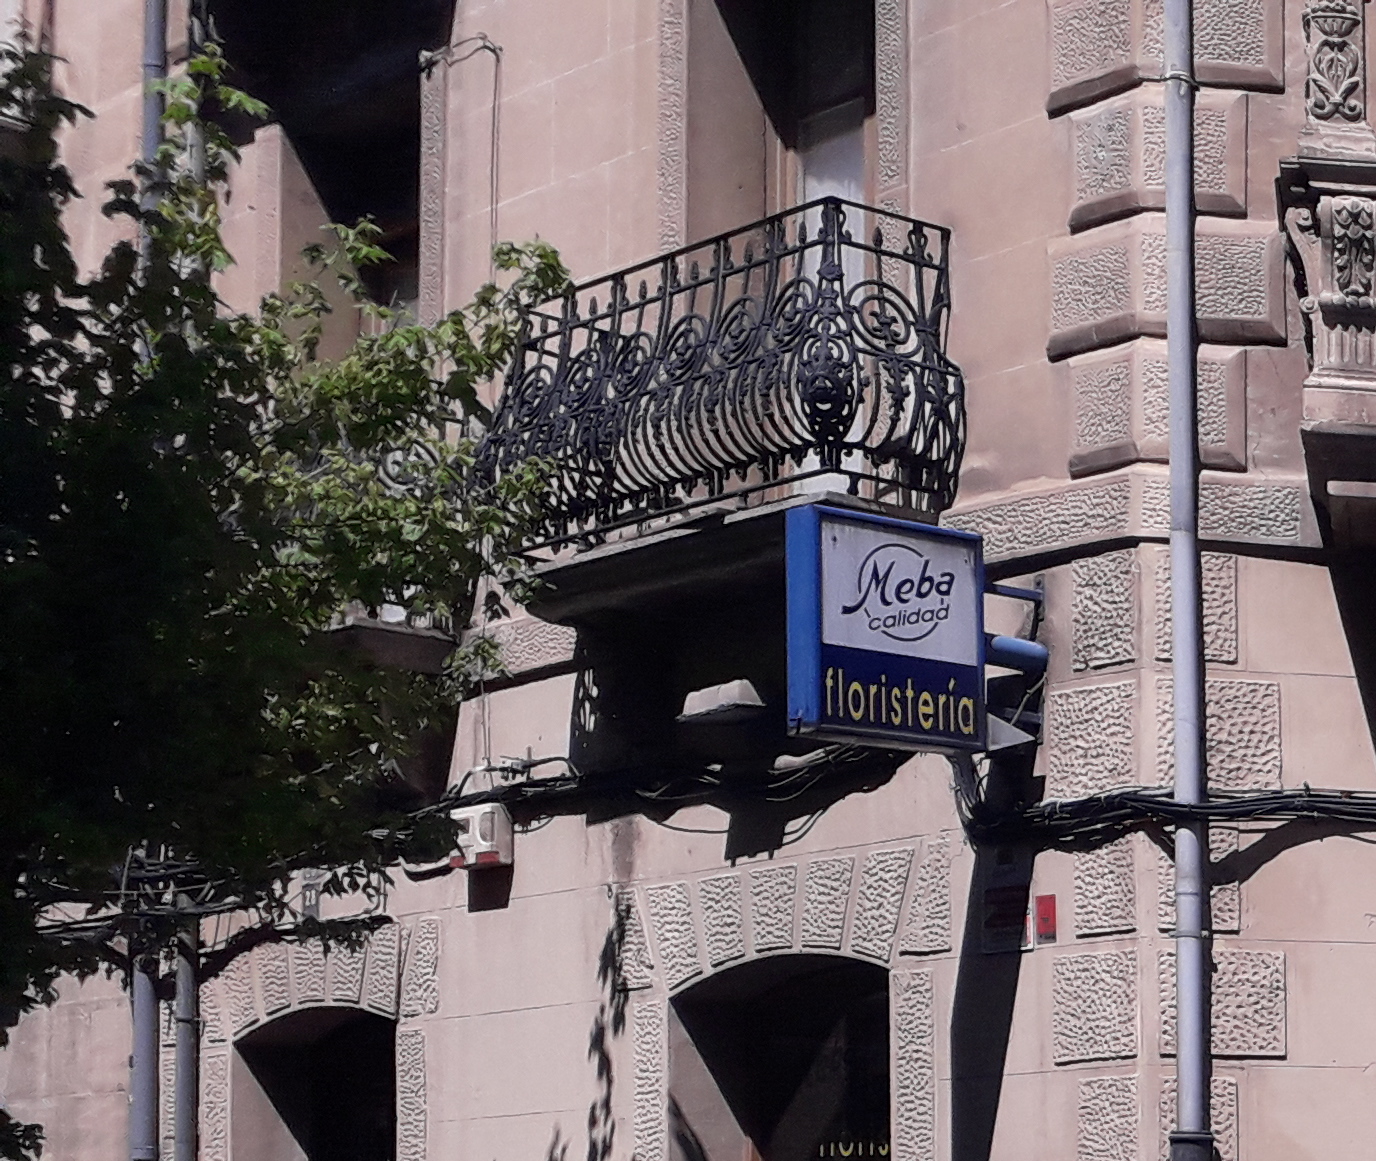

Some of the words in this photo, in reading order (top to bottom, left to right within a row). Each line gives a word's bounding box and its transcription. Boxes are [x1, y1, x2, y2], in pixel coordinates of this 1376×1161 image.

[841, 559, 955, 615] Meba
[868, 603, 950, 632] calidad
[825, 666, 974, 735] floristería
